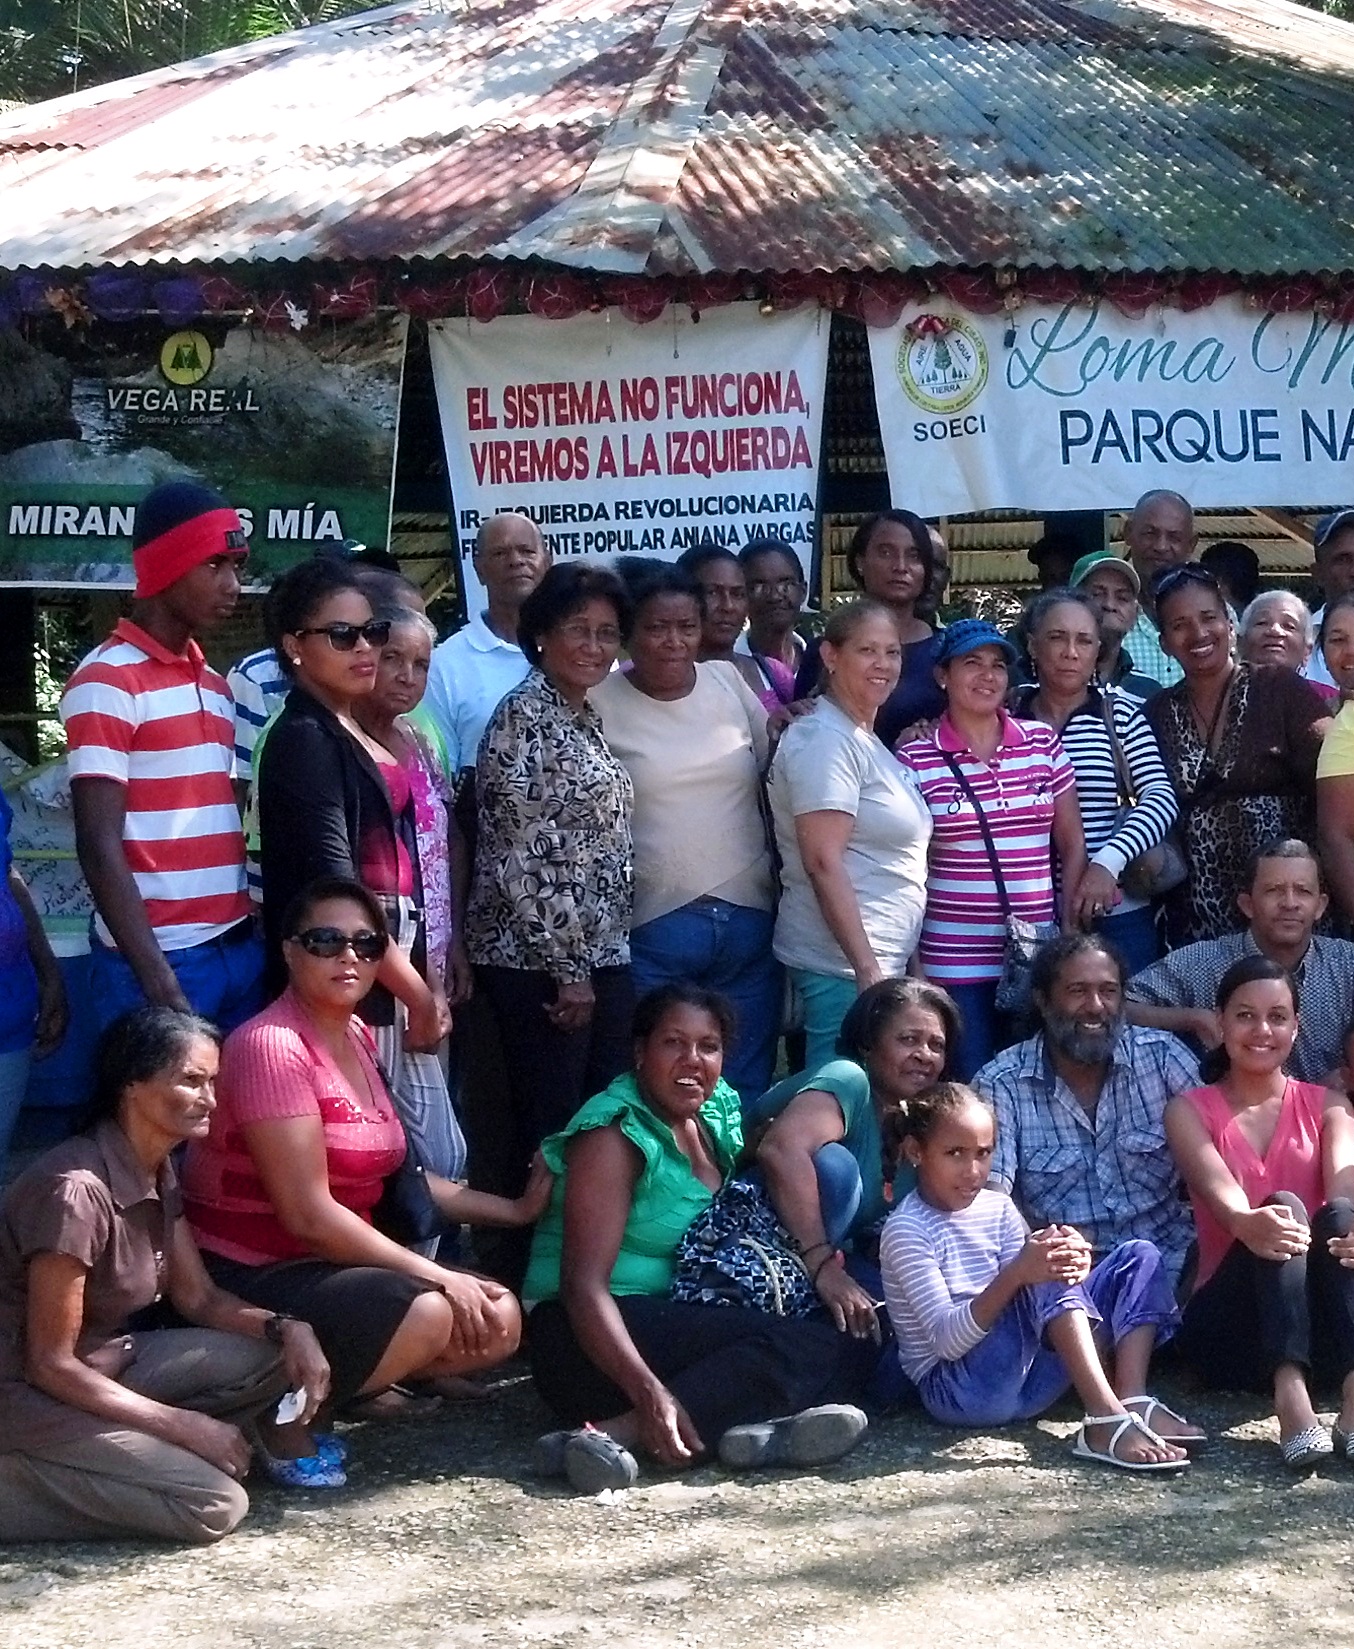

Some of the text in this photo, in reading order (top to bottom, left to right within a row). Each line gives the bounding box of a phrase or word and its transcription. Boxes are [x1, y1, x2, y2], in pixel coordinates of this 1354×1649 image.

[916, 344, 928, 366] AIRE
[954, 339, 973, 362] AGUA
[1006, 296, 1236, 397] Loma
[107, 388, 179, 411] VEGA
[466, 369, 810, 431] EL SISTEMA NO FUNCIONA,
[930, 383, 962, 395] TIERRA
[913, 414, 987, 442] SOECI
[1059, 408, 1282, 465] PARQUE
[469, 425, 813, 487] VIREMOS A LA IZQUIERDA
[9, 502, 344, 541] MIRAN S MÍA
[614, 491, 816, 521] REVOLUCIONARIA
[583, 527, 667, 554] POPULAR
[670, 523, 741, 549] ANIANA
[744, 520, 815, 544] VARGAS
